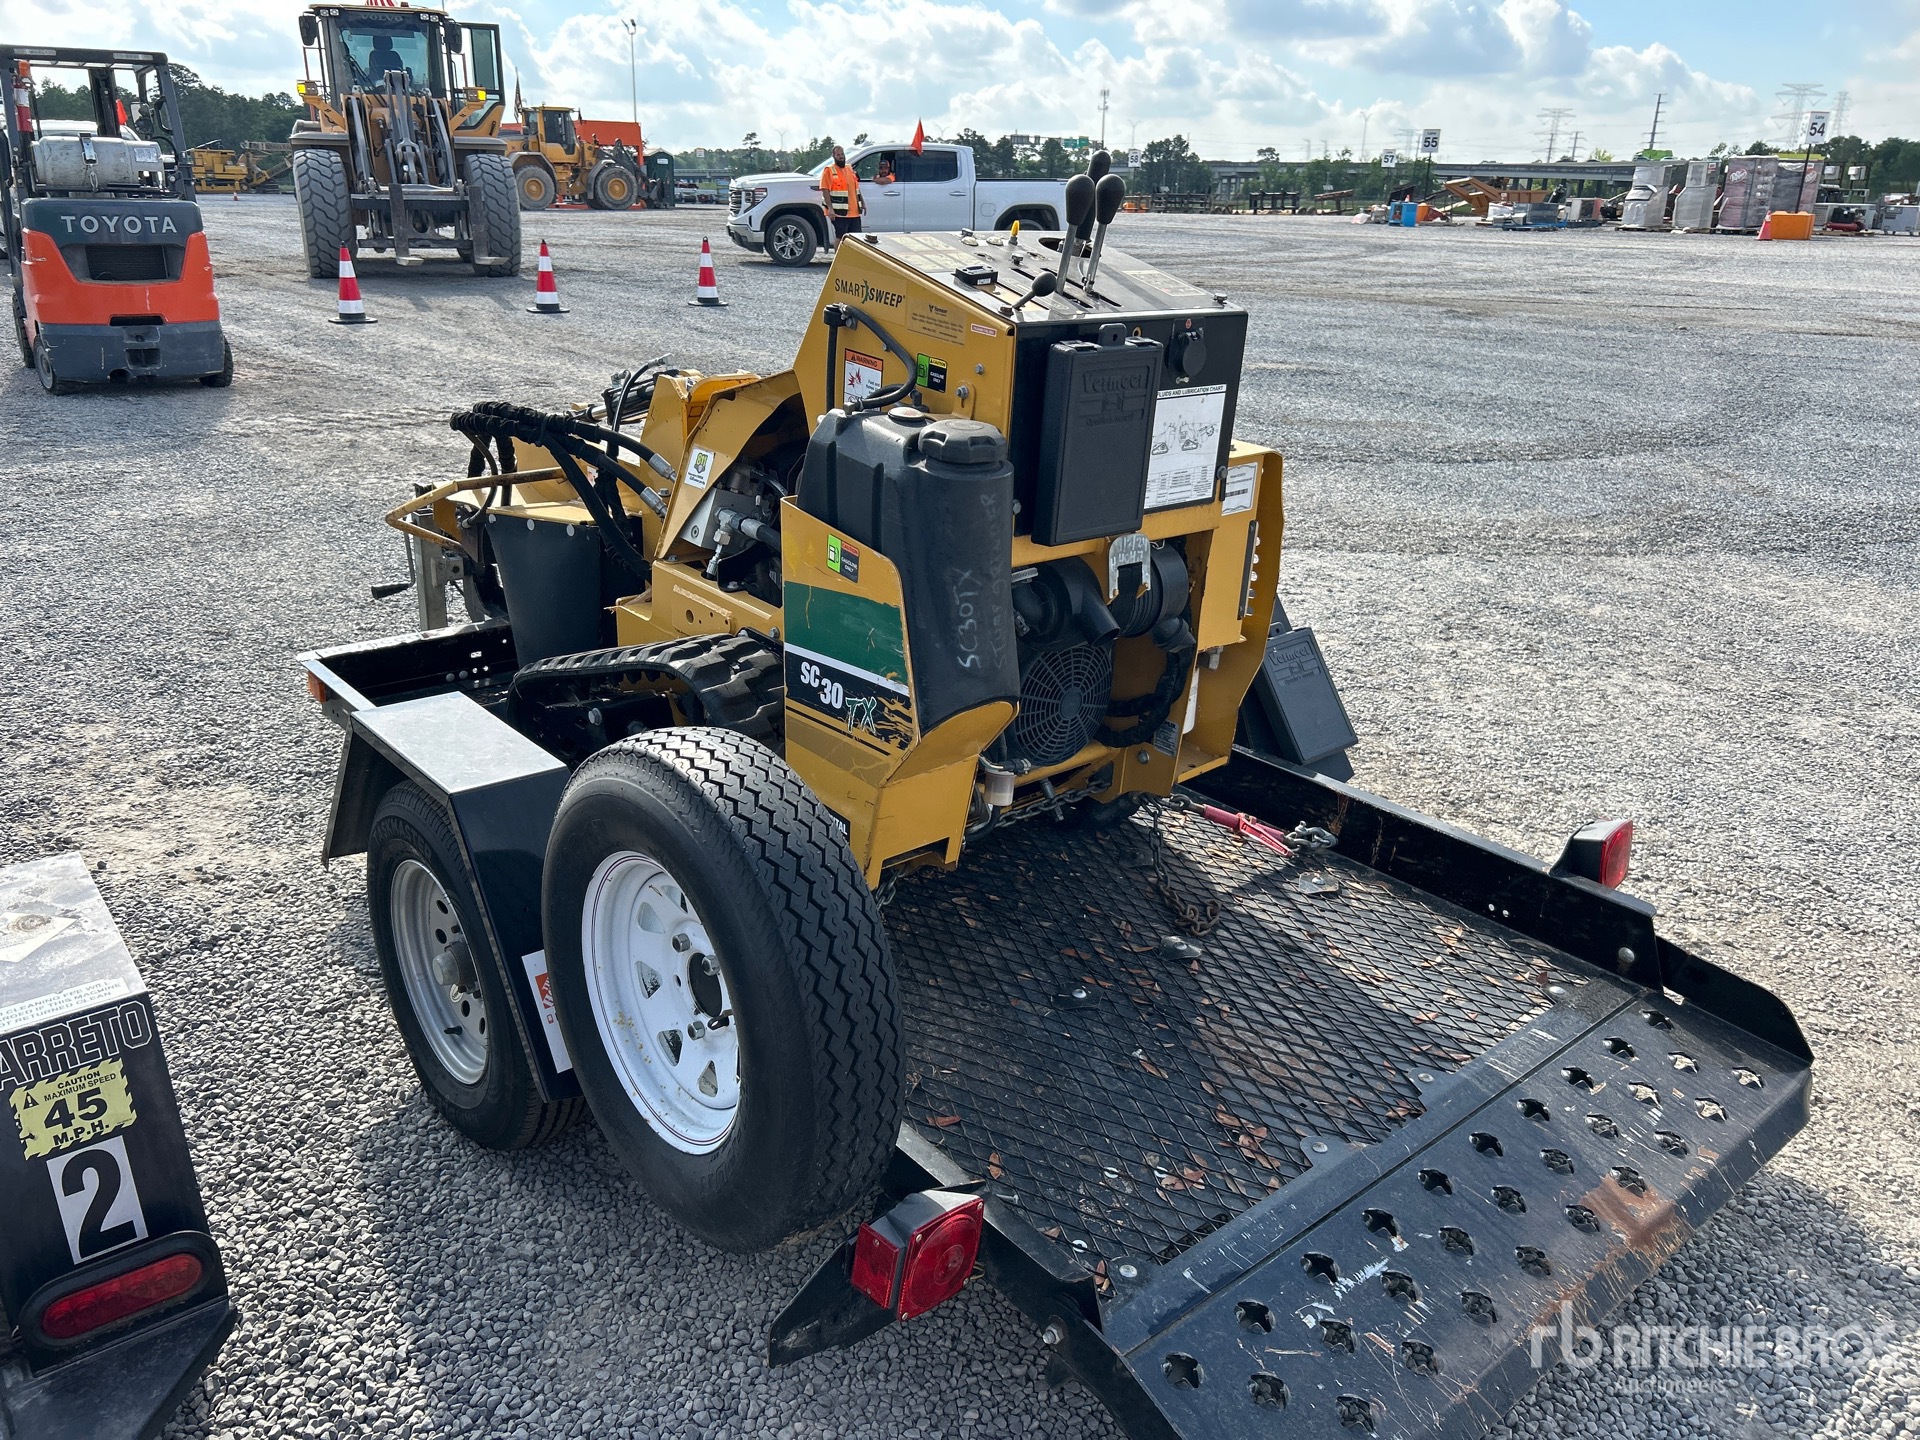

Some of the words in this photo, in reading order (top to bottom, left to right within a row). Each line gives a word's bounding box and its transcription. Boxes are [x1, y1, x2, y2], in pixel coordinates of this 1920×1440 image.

[361, 13, 403, 21] VOLVO
[1809, 122, 1826, 137] 54
[1423, 137, 1438, 147] 55
[1383, 155, 1395, 163] 57
[60, 215, 178, 234] TOYOTA
[835, 278, 866, 299] SMART
[856, 355, 878, 367] WARNING
[930, 371, 944, 380] GASOLINE
[1182, 386, 1210, 395] LUBRICATION
[841, 556, 857, 570] GASOLINE
[844, 564, 854, 573] ONLY
[845, 696, 877, 736] TX
[6, 995, 61, 1015] CLEANING
[48, 998, 72, 1009] THIS
[74, 983, 121, 1002] MACHINE
[15, 1002, 74, 1024] RETURNED
[75, 991, 112, 1005] CLEAN
[44, 1082, 86, 1102] MAXIMUM
[87, 1072, 117, 1087] SPEED
[57, 1071, 101, 1090] CAUTION
[44, 1087, 108, 1129] 45
[52, 1120, 110, 1146] M.P.H.
[61, 1148, 138, 1260] 2
